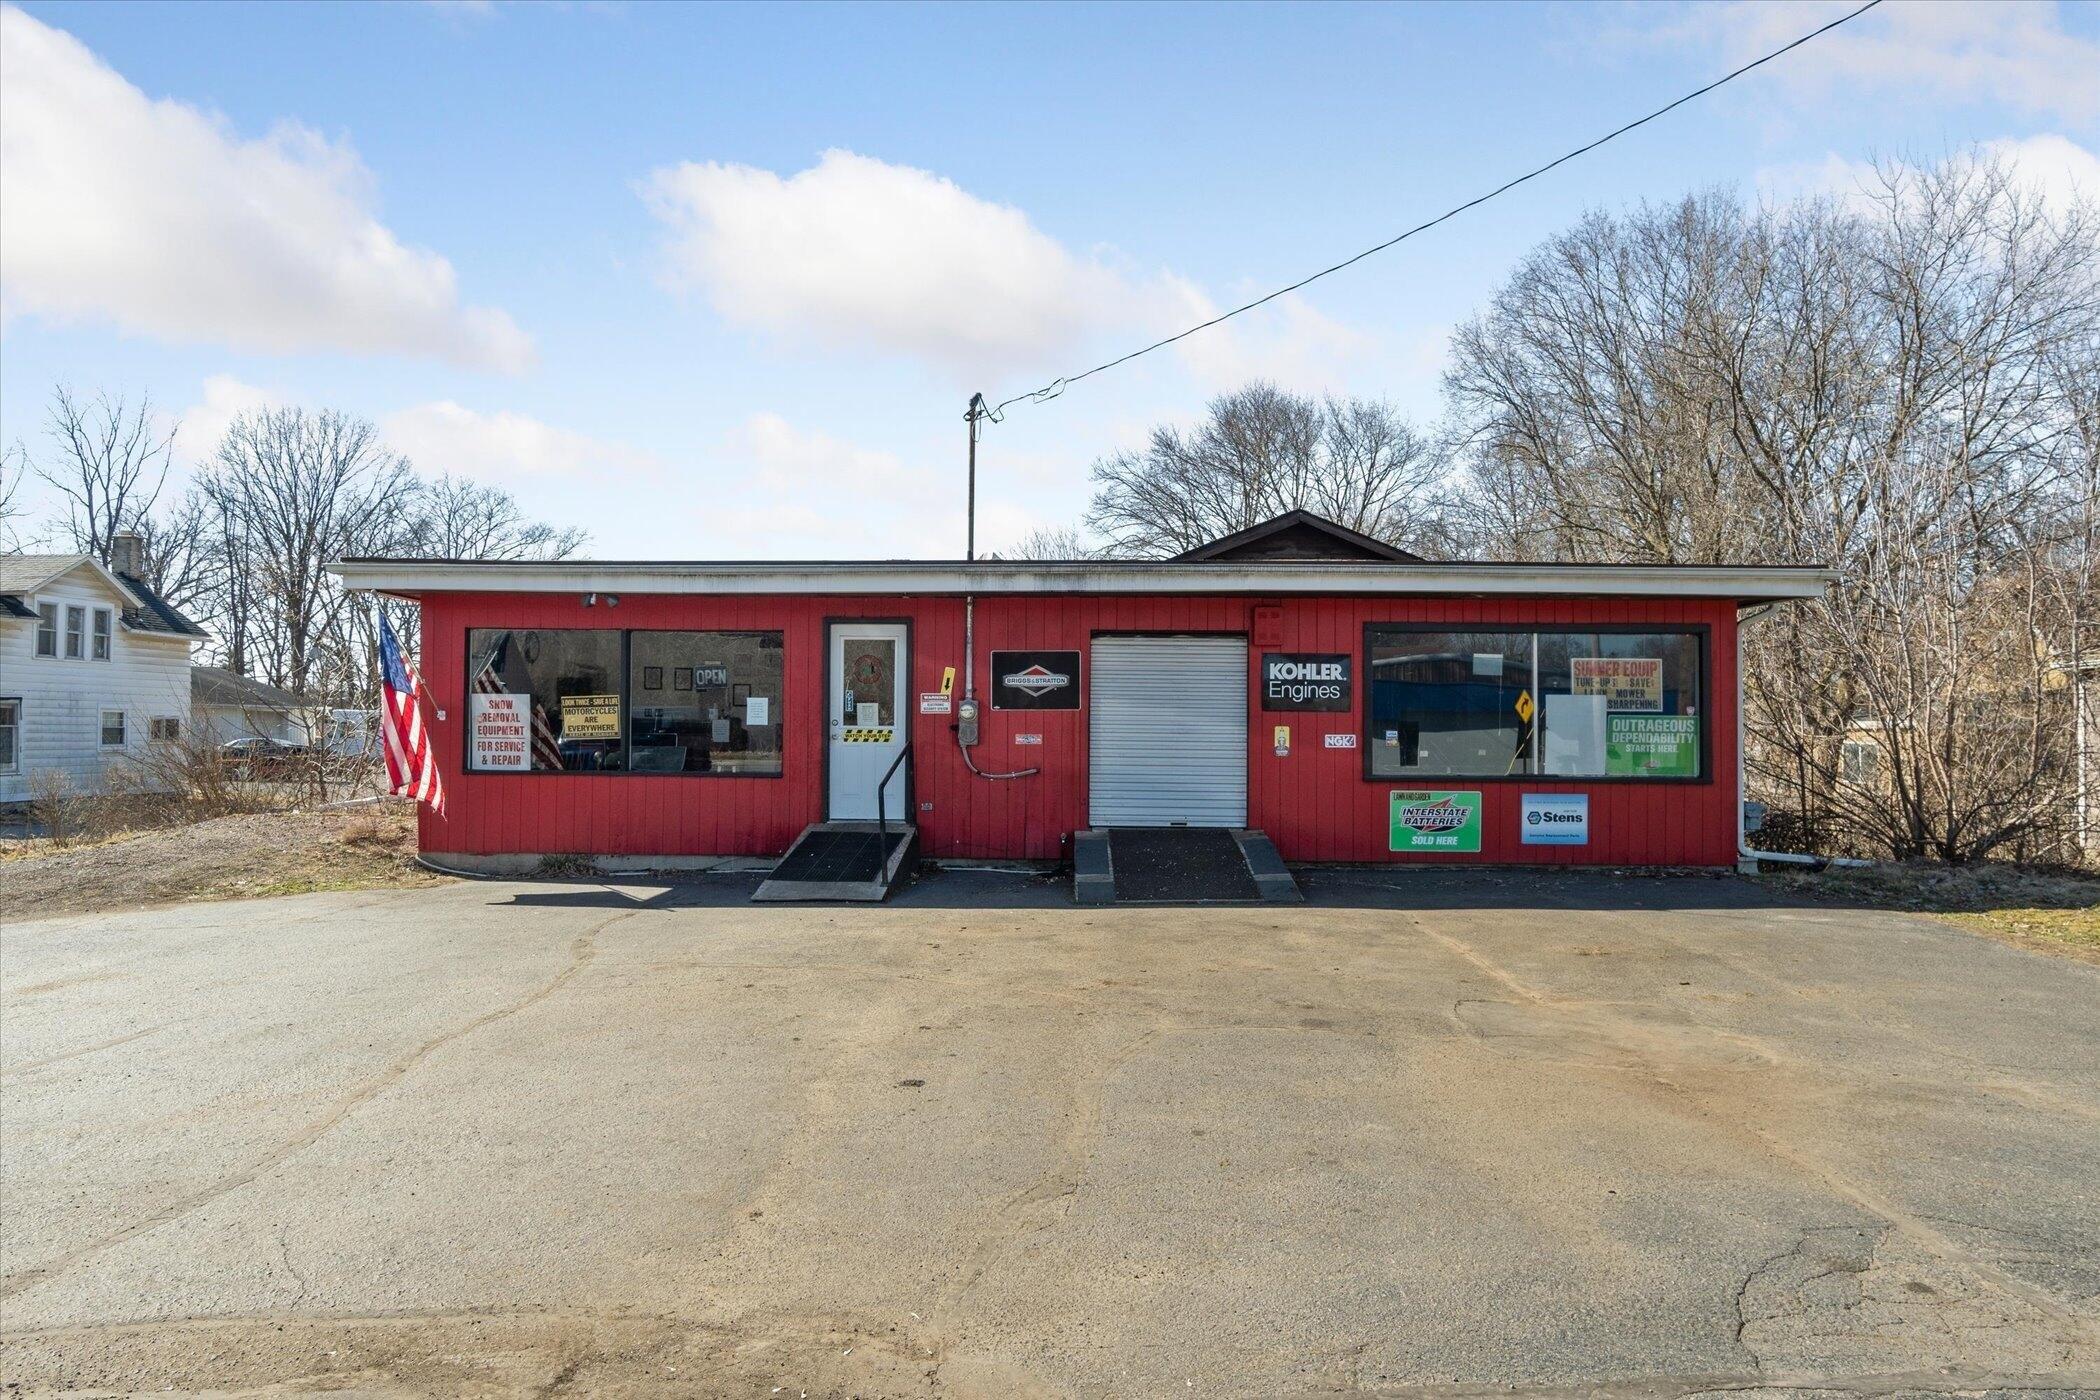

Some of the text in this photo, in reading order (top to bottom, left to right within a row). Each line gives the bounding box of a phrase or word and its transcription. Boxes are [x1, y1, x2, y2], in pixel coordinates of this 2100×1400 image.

[1574, 661, 1658, 677] SUMMER EQUIP
[696, 669, 727, 685] OPEN
[1269, 681, 1340, 702] Engines
[1615, 689, 1646, 699] MOWER
[488, 699, 513, 710] SNOW
[1607, 700, 1659, 710] SHARPENING
[480, 712, 521, 723] REMOVAL
[477, 725, 525, 736] EQUIPMENT
[567, 724, 616, 732] EVERYWHERE
[1612, 719, 1695, 732] OUTRAGEOUS
[1326, 735, 1351, 747] NGK
[1612, 732, 1694, 743] DEPENDABILITY
[477, 741, 526, 752] FOR SERVICE
[1625, 744, 1656, 753] STARTS
[481, 754, 522, 766] & REPAIR
[1402, 808, 1468, 816] INTERSTATE
[1543, 811, 1583, 823] Stens
[1404, 817, 1463, 825] BATTERIES
[1411, 836, 1458, 845] SOLD HERE
